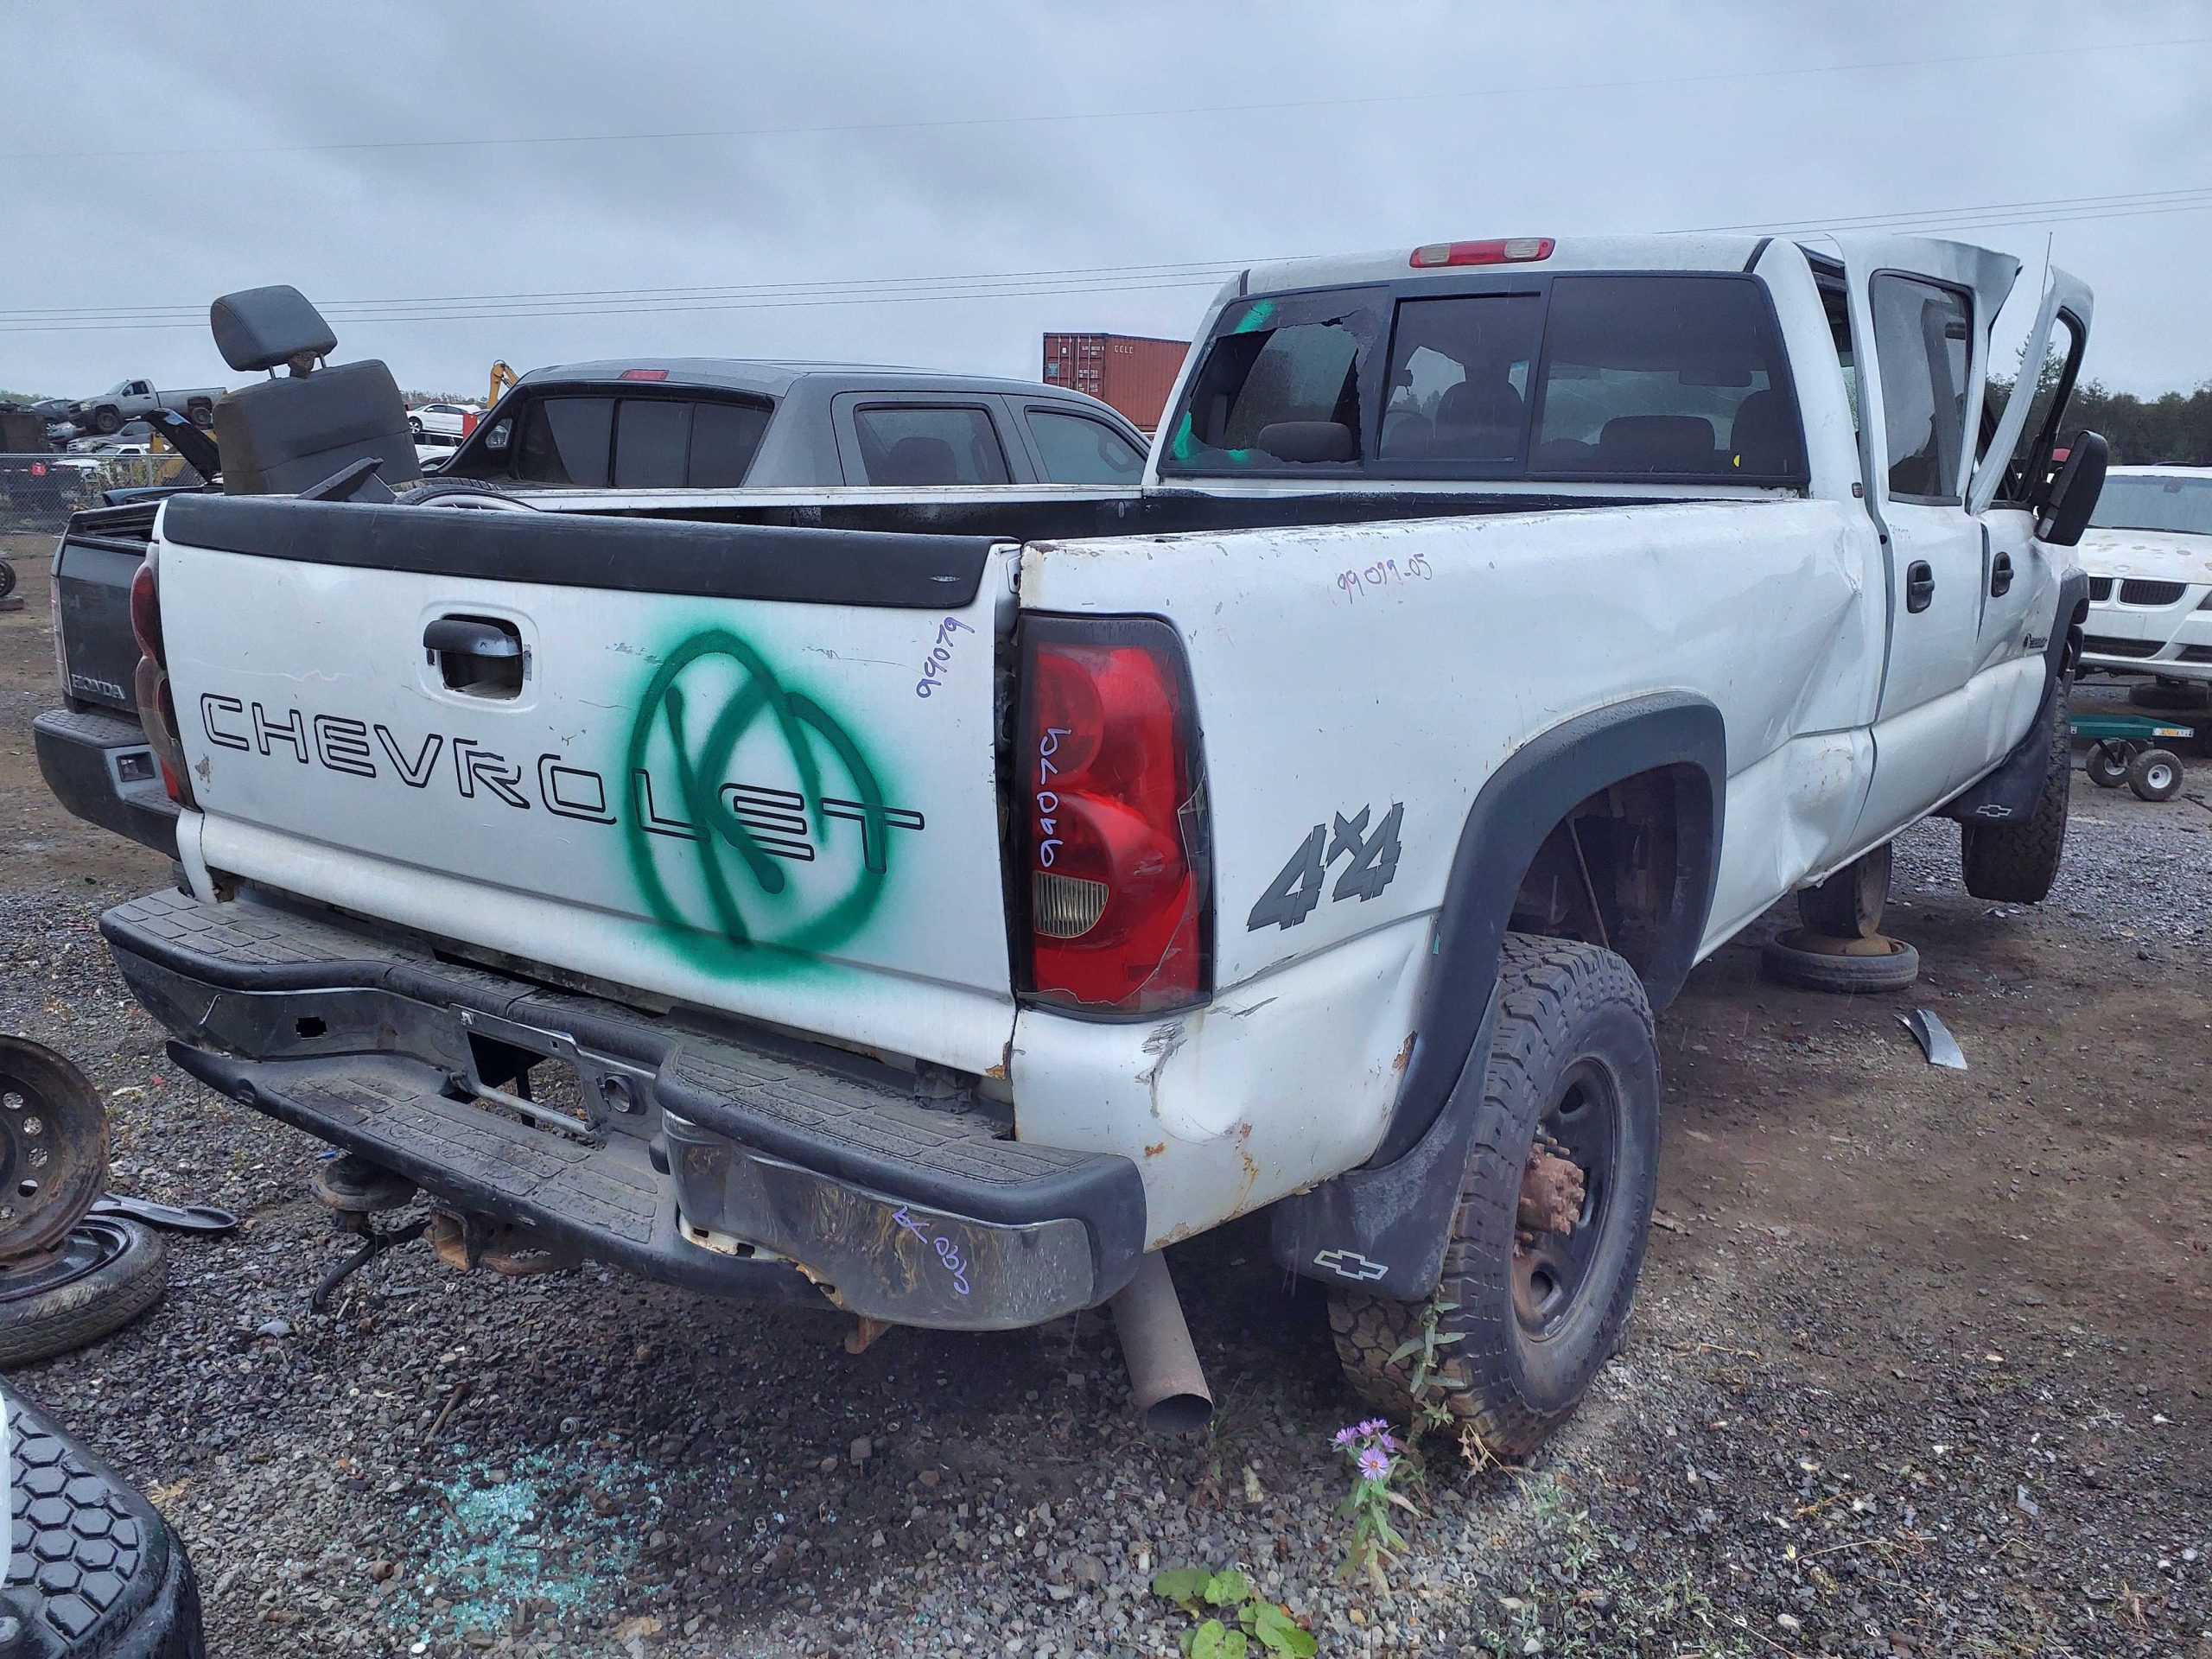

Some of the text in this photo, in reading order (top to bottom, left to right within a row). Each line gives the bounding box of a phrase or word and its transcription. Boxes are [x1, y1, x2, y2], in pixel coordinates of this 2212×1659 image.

[71, 673, 126, 700] HONDA
[916, 616, 976, 698] 99079
[200, 692, 925, 874] CHEVROLET
[1037, 728, 1072, 868] 99079
